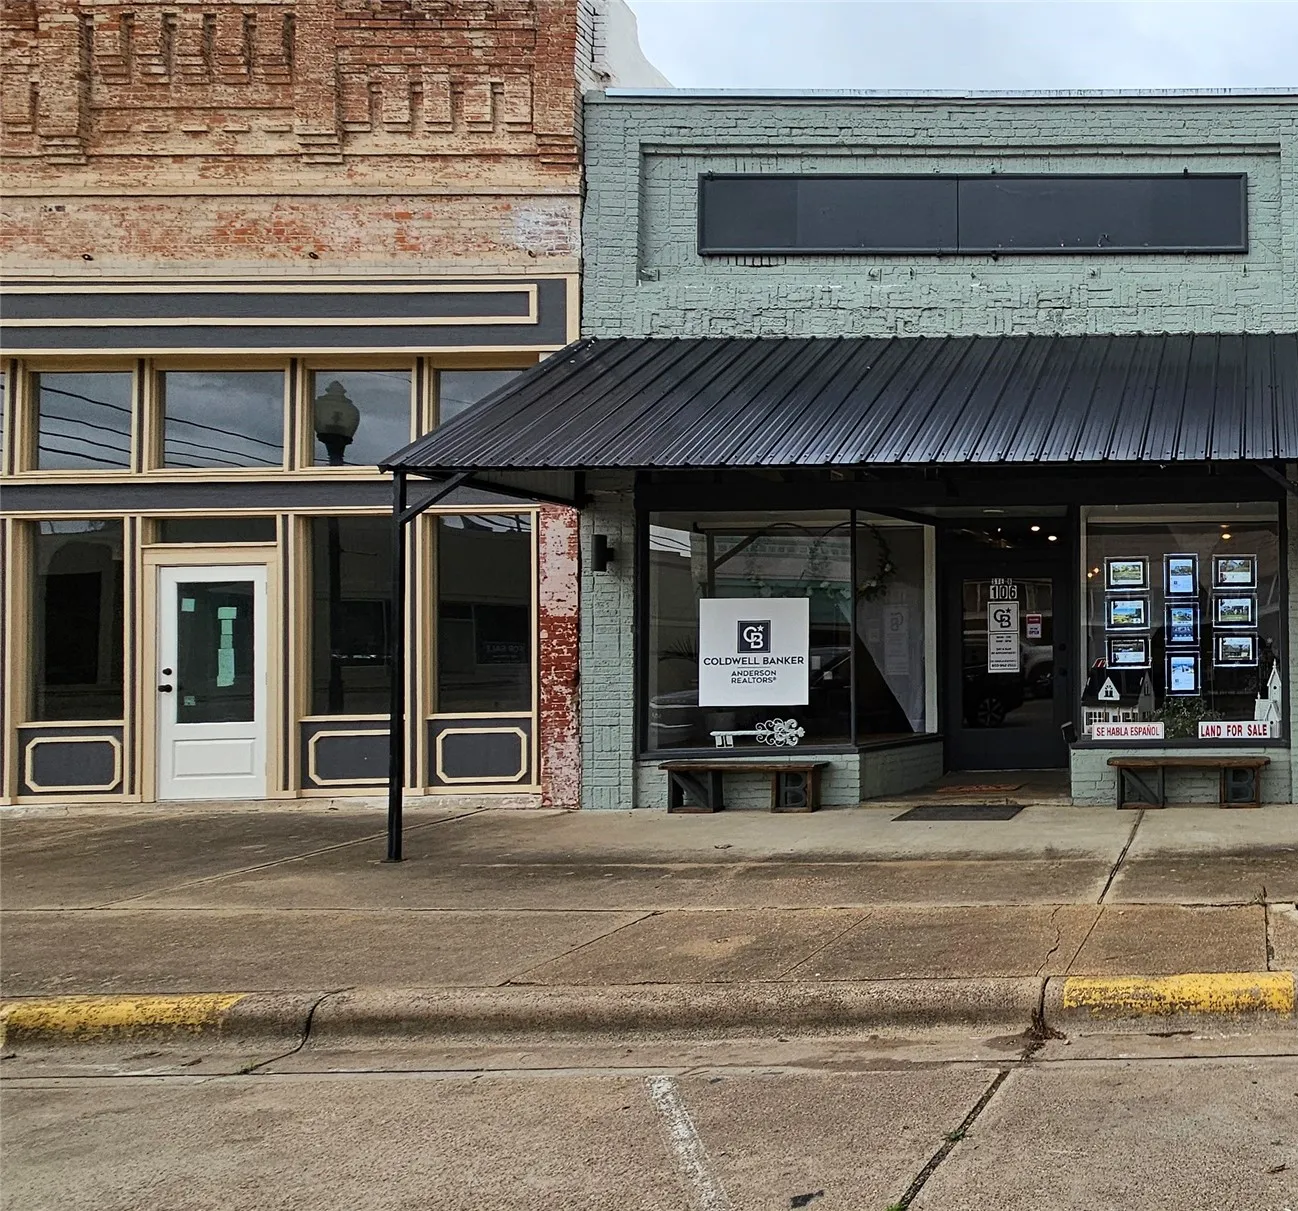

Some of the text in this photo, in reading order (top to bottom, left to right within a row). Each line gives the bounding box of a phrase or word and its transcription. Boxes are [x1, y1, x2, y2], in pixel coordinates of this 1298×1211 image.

[990, 585, 1018, 600] 106
[703, 656, 804, 666] COLDWELL BANKER
[1096, 724, 1160, 737] SE HABLA ESPAÑOL
[1200, 724, 1268, 737] LAND FOR SALE
